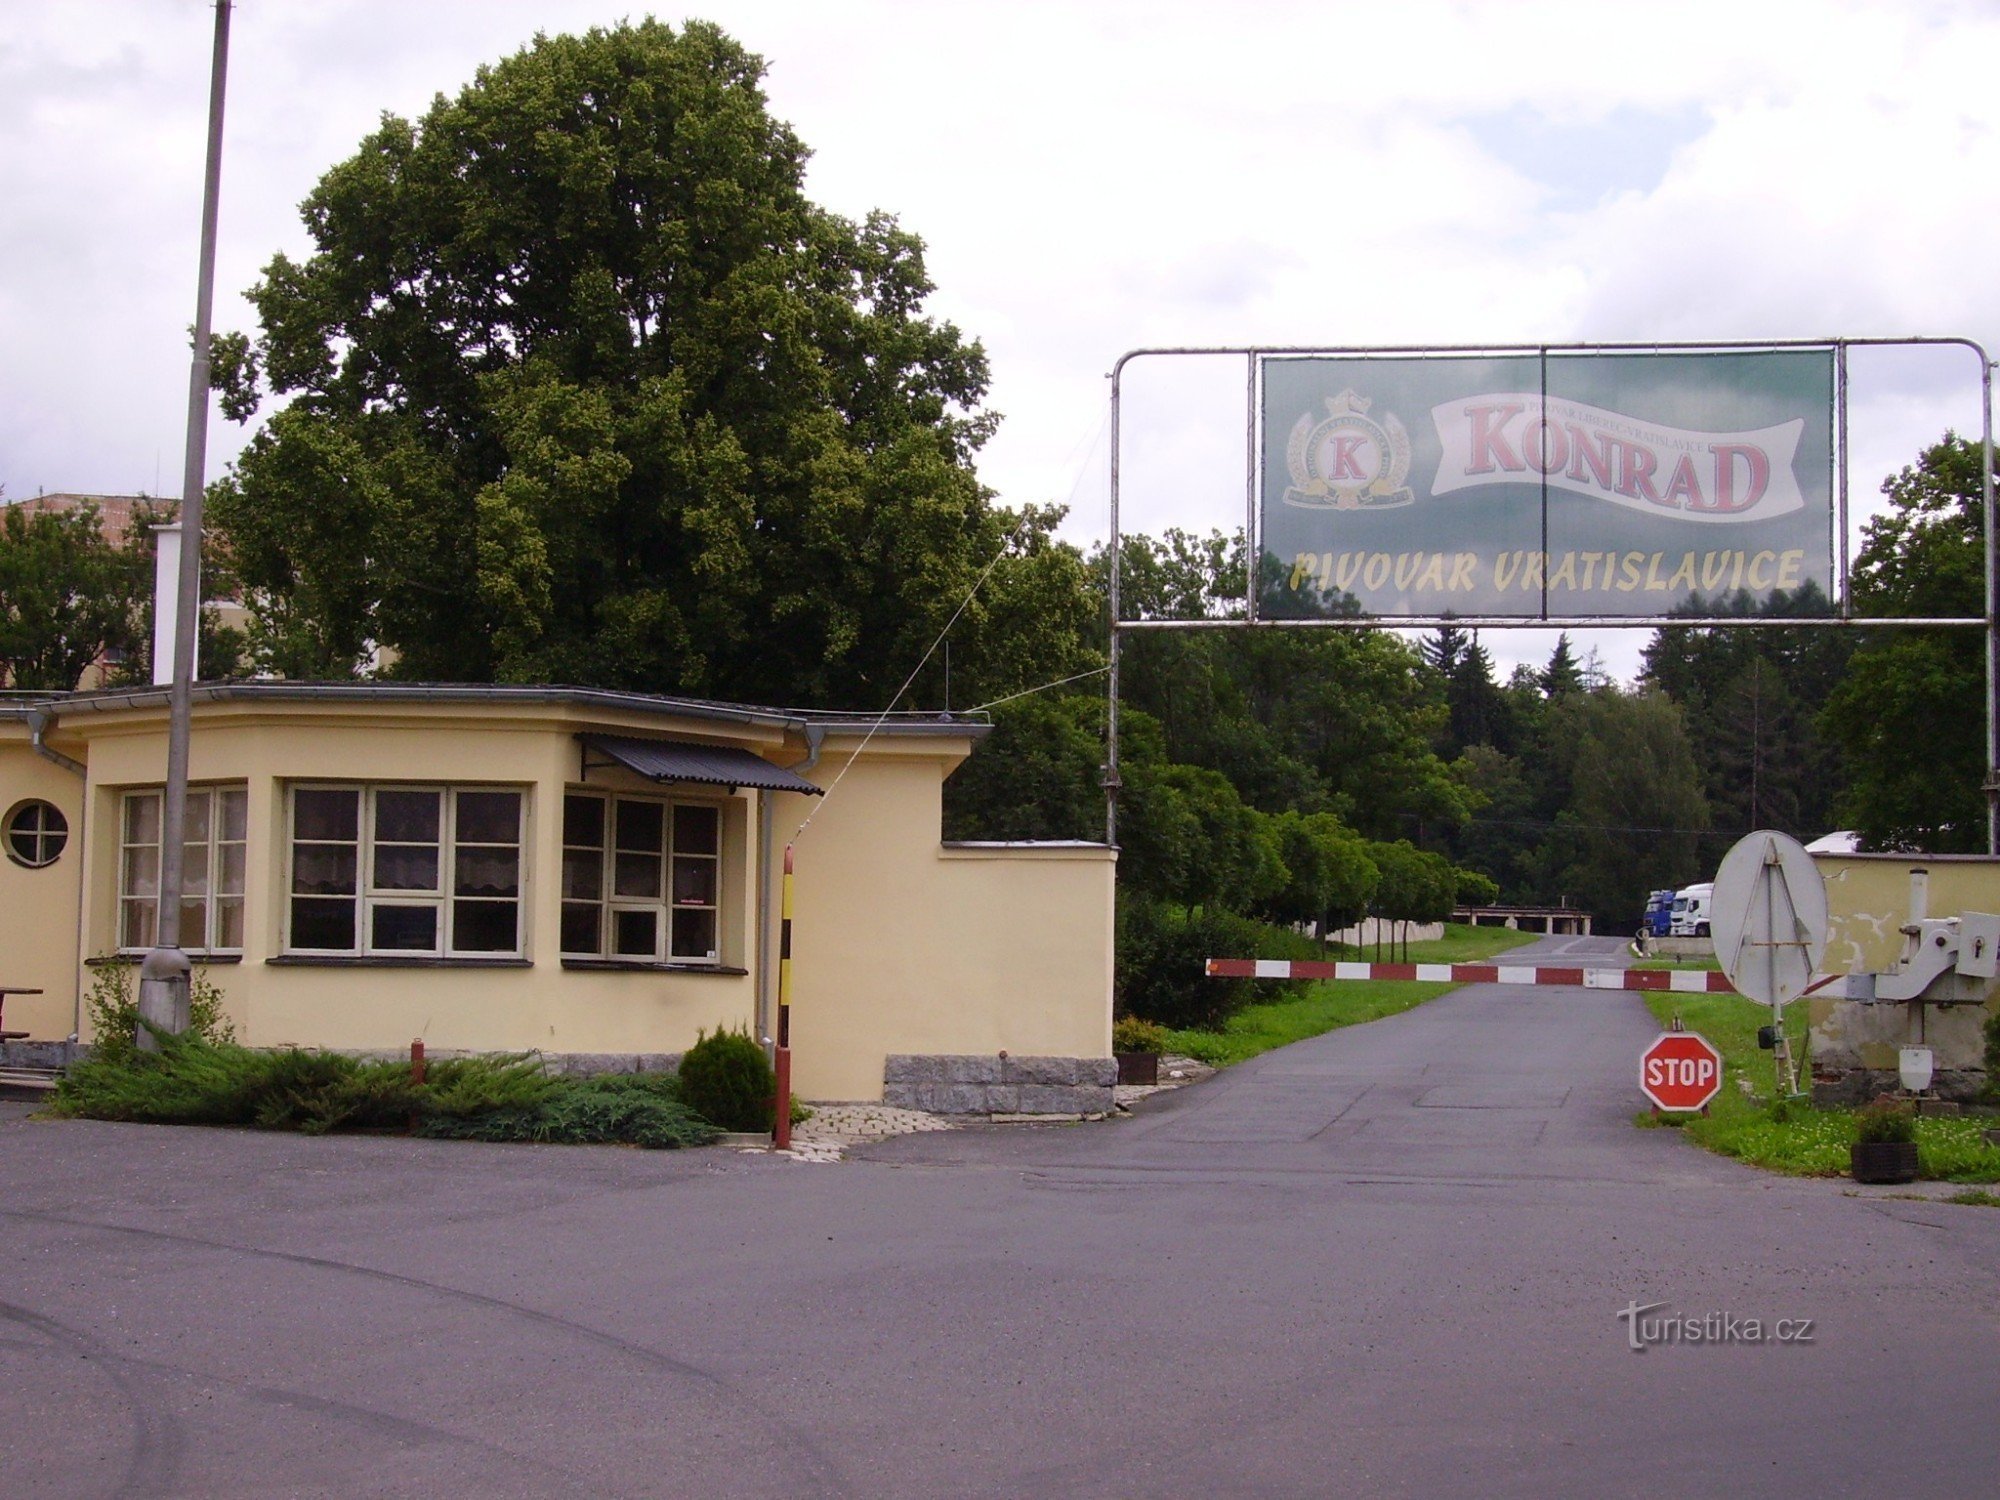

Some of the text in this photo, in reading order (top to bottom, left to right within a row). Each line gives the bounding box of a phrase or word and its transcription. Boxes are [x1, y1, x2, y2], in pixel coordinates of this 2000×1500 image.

[1529, 402, 1576, 418] PIOVAR
[1329, 437, 1367, 480] K
[1464, 403, 1770, 513] KONRAD
[1289, 550, 1804, 592] PIVOVAR VRATISLAVICE
[1648, 1058, 1713, 1086] STOP
